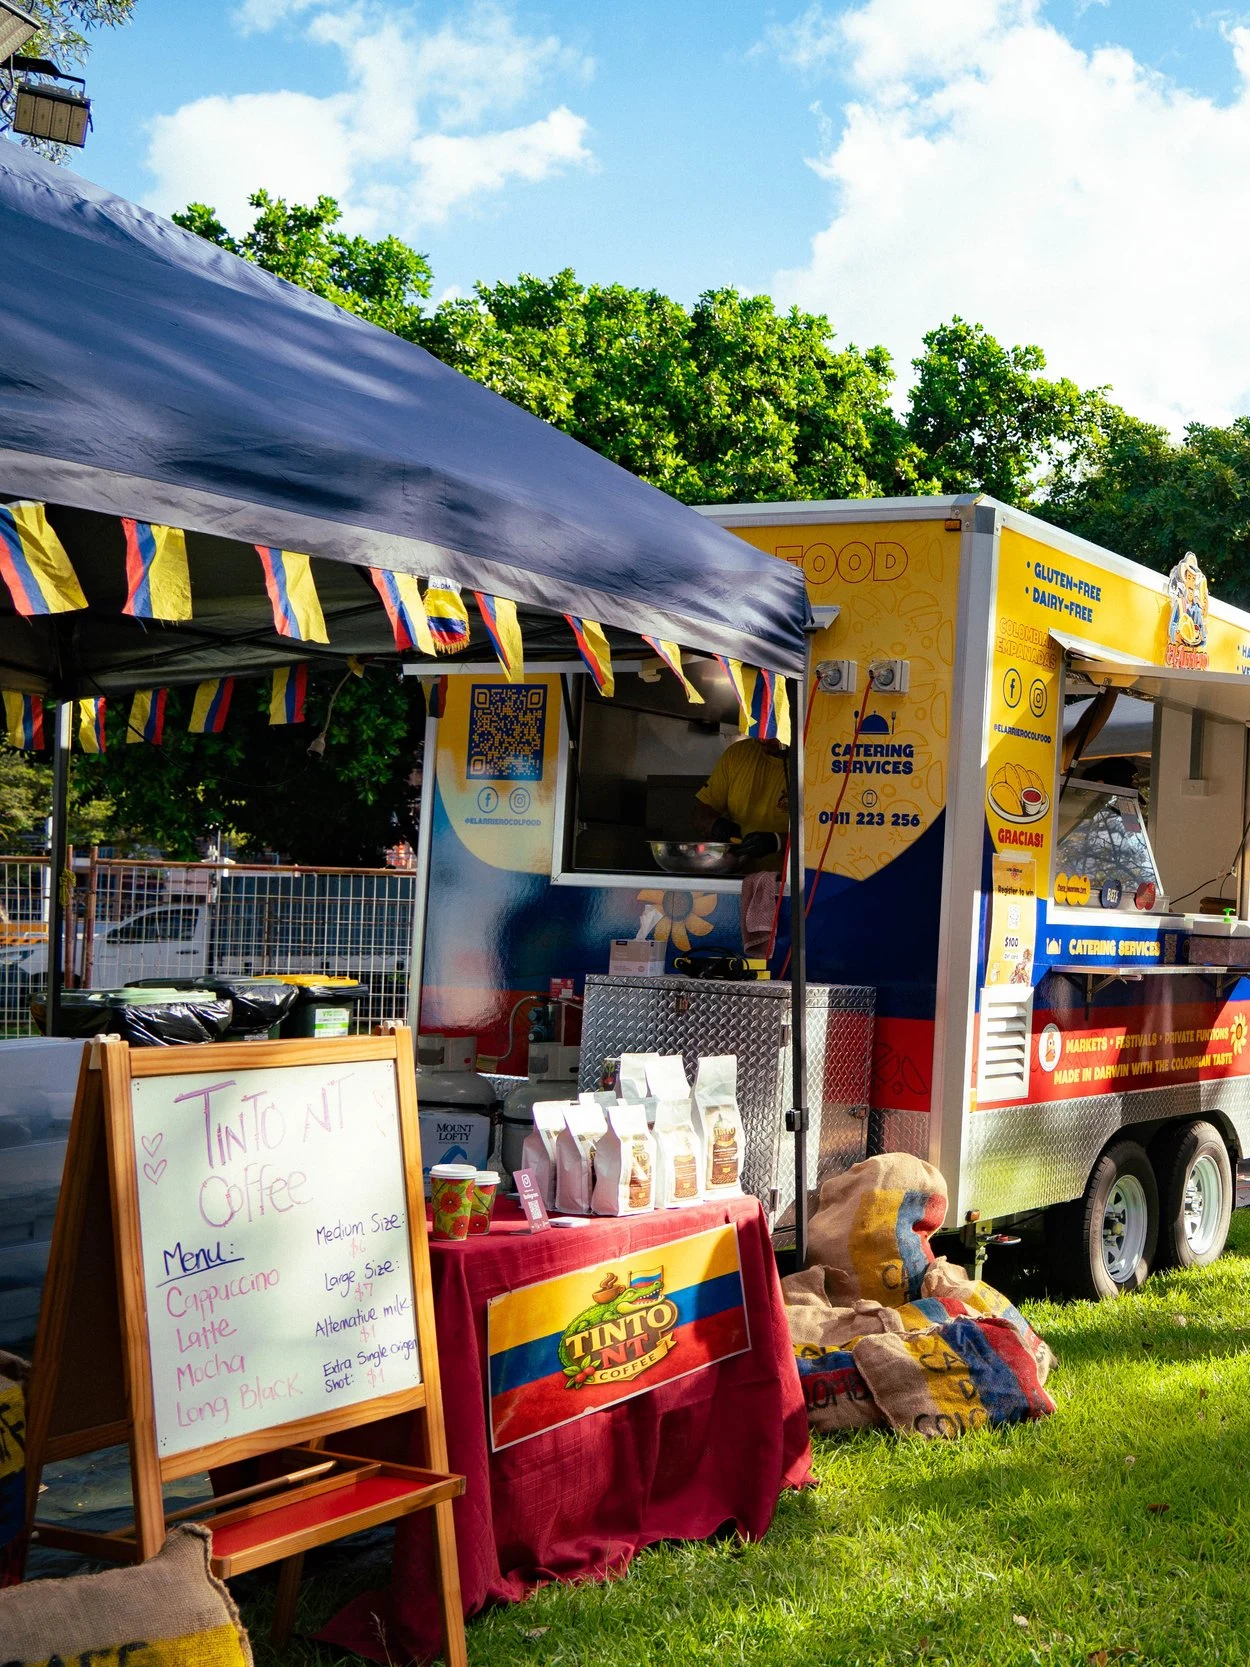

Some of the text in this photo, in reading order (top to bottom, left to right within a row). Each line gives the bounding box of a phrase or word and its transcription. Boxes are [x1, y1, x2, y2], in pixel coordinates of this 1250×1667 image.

[1034, 562, 1101, 602] GLUTEN-FREE
[1032, 587, 1093, 623] DAIRY-FREE
[1000, 617, 1056, 650] COLOMBIAN
[996, 636, 1057, 670] EMPANADAS
[831, 743, 914, 758] CATERING
[831, 760, 913, 775] SERVICES
[856, 812, 885, 826] 223
[891, 813, 920, 827] 256
[997, 827, 1044, 848] GRACIAS!
[998, 885, 1034, 897] Register to win
[1004, 937, 1019, 948] $100
[1069, 938, 1161, 957] CATERING SERVICES
[1065, 1036, 1108, 1053] MARKETS
[1115, 1033, 1158, 1049] FESTIVALS
[1164, 1031, 1195, 1045] PRIVATE
[1053, 1052, 1233, 1085] MADE IN DARWIN WITH THE COLOMBIAN TASTE
[303, 1073, 355, 1142] NT
[436, 1123, 475, 1133] MOUNT
[438, 1132, 471, 1141] LOFTY
[199, 1162, 313, 1228] Coffee
[316, 1219, 365, 1246] Medium
[166, 1269, 280, 1322] Cappuccino
[324, 1270, 355, 1298] Large
[354, 1282, 373, 1302] $7
[176, 1318, 237, 1354] Latte
[360, 1324, 376, 1343] $1
[566, 1304, 672, 1359] TINTO
[323, 1359, 352, 1377] Extra
[357, 1344, 388, 1368] Single
[600, 1333, 649, 1369] NT
[176, 1353, 246, 1392] Mocha
[367, 1367, 384, 1388] $1
[599, 1352, 657, 1380] COFFEE
[176, 1396, 230, 1428] Long
